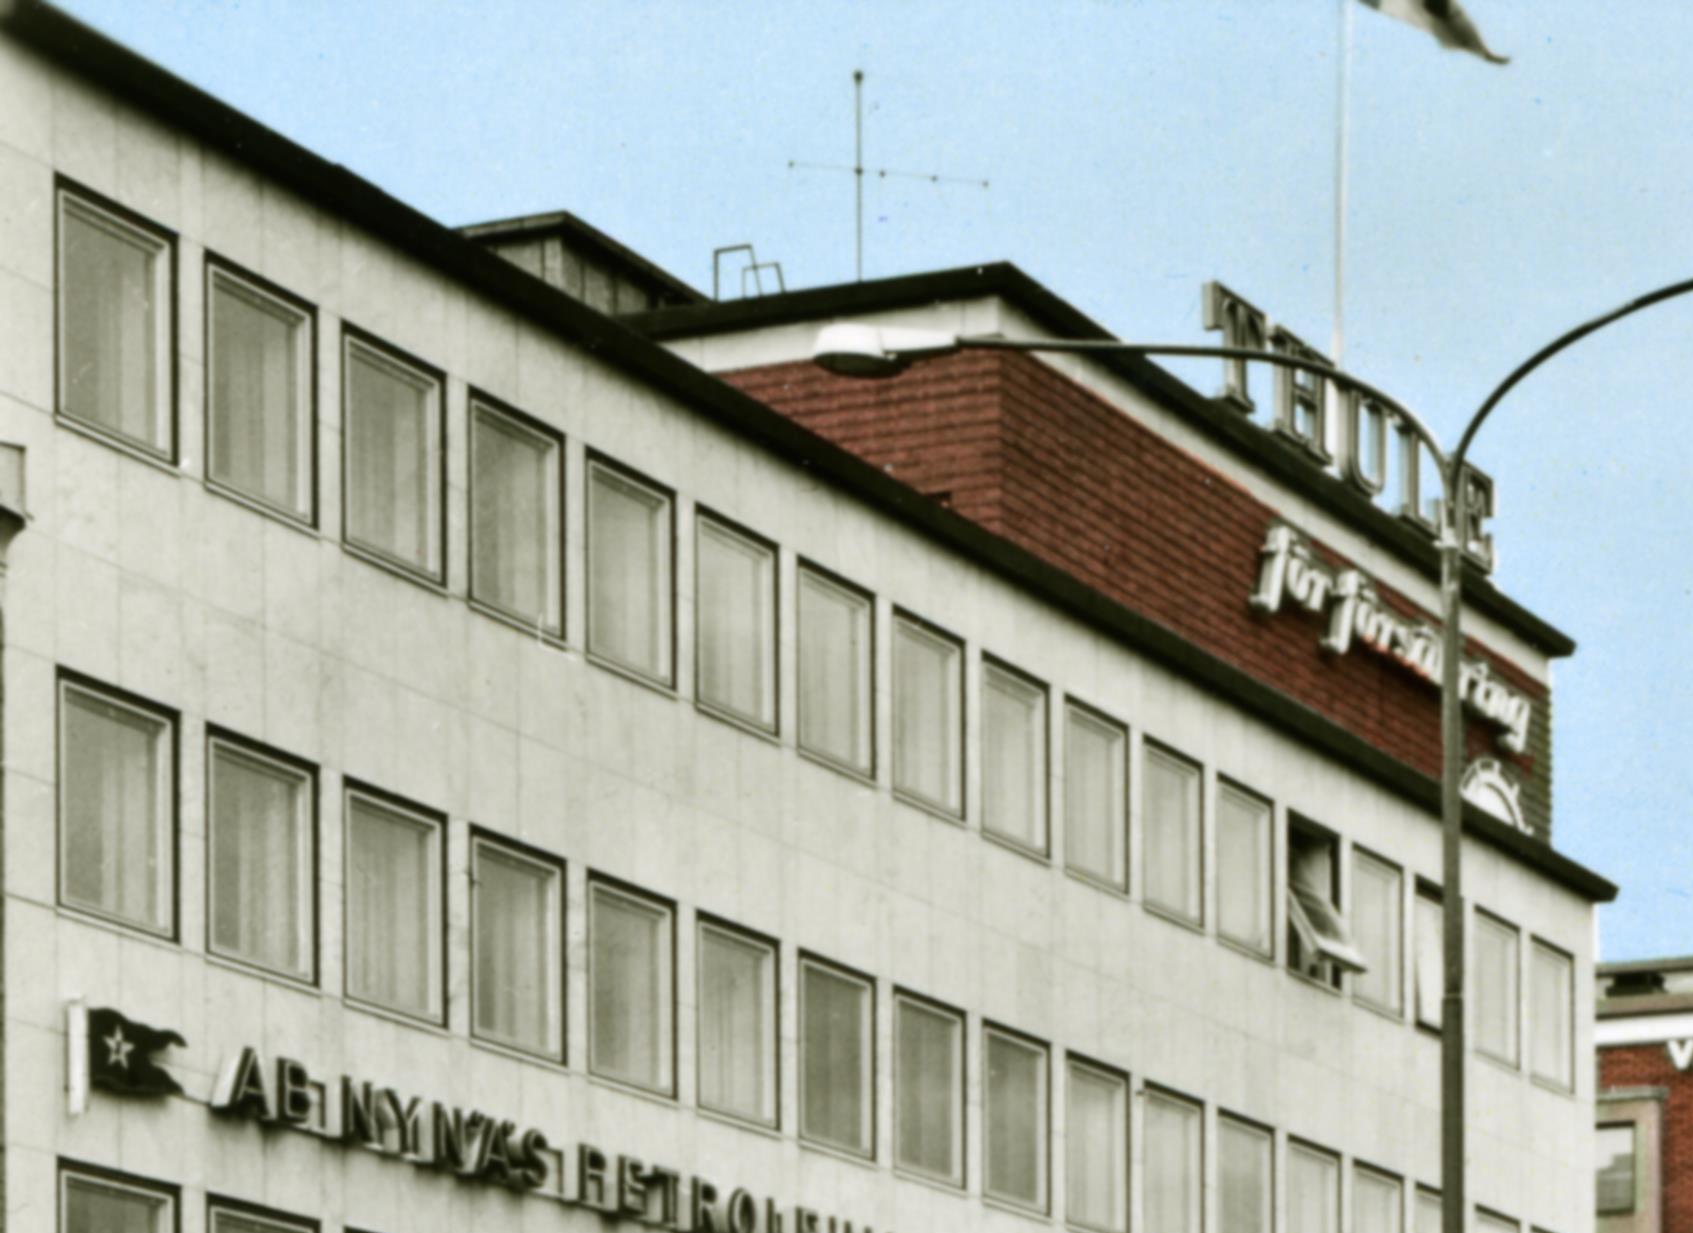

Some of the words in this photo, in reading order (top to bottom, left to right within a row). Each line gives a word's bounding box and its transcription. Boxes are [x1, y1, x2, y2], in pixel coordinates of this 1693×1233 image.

[1202, 280, 1494, 577] THULE
[1318, 569, 1531, 752] försäring
[212, 1045, 310, 1130] AB
[328, 1073, 550, 1190] NYNÄS
